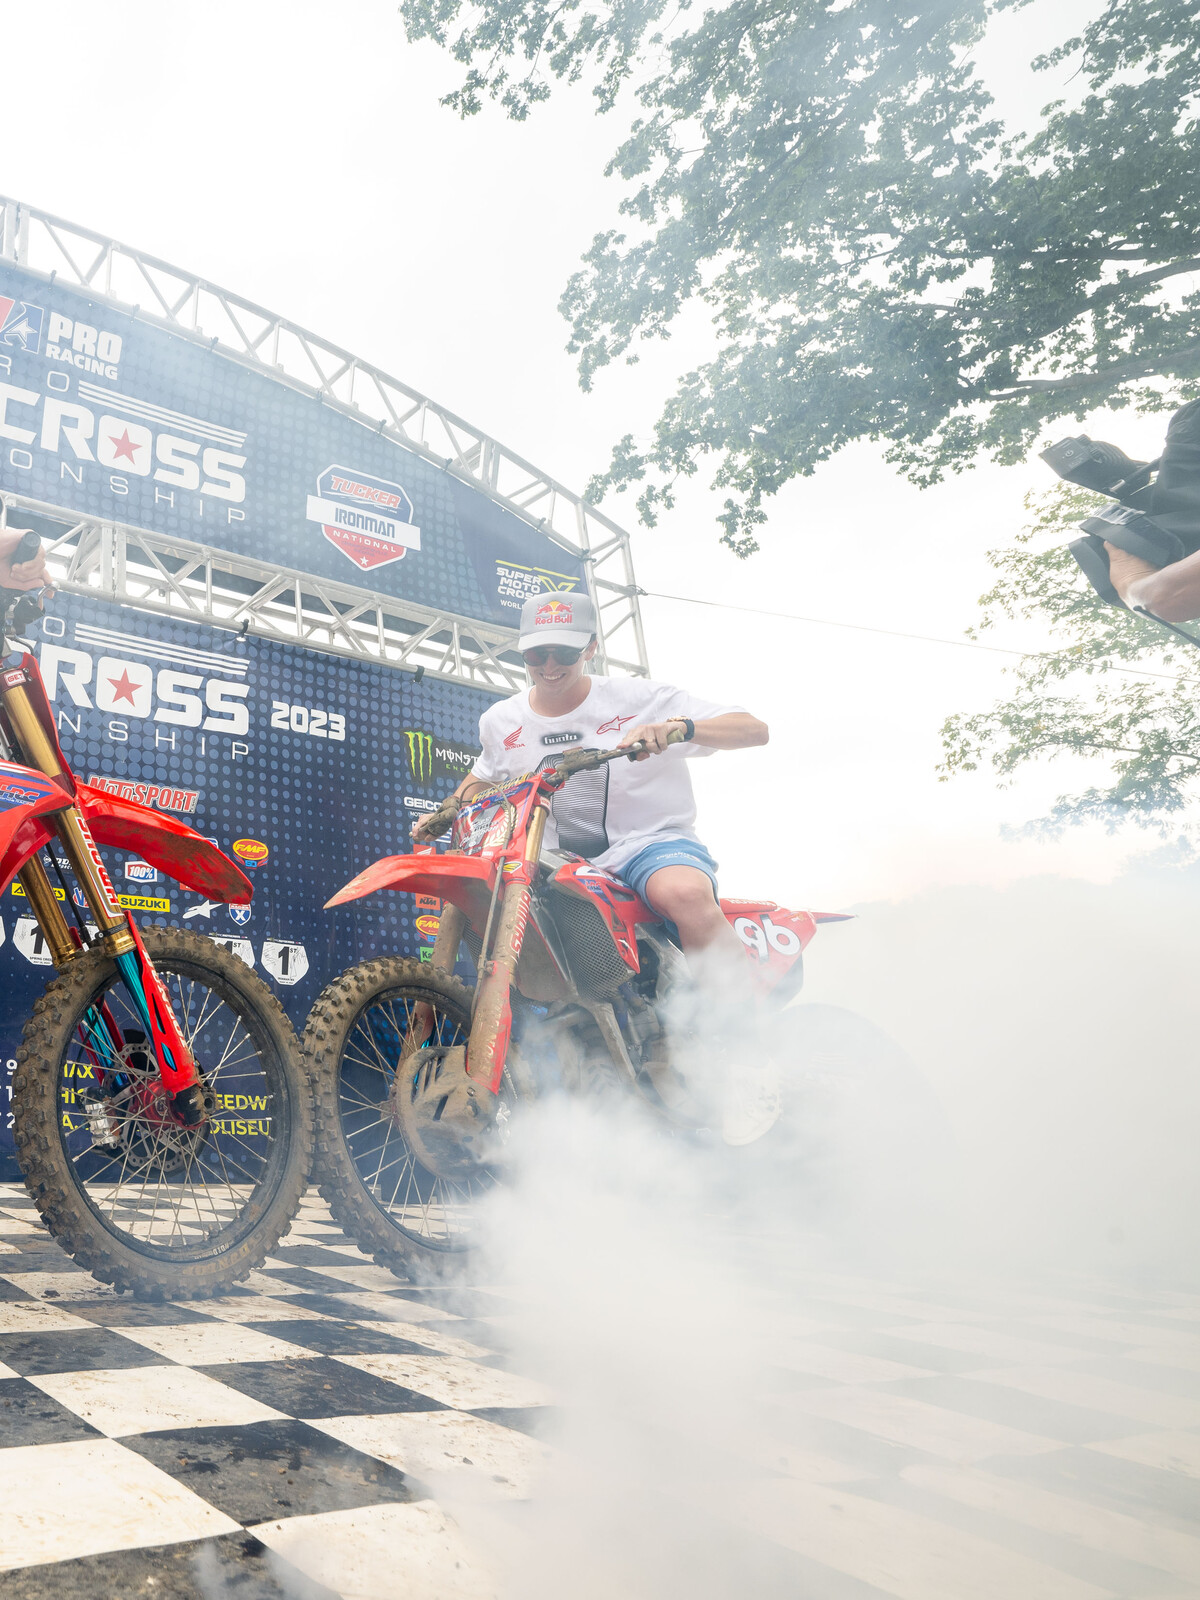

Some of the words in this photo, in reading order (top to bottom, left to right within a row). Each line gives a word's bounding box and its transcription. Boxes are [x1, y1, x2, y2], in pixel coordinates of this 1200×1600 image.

[47, 311, 123, 364] PRO
[45, 343, 118, 380] RACING
[330, 474, 401, 509] TUCKER
[335, 507, 396, 539] IRONMAN
[333, 530, 397, 553] NATIONAL
[496, 567, 542, 586] SUPER
[497, 586, 535, 600] CROS
[500, 576, 541, 594] MOTO
[500, 599, 524, 610] WORL
[535, 614, 553, 625] Red
[554, 614, 573, 624] Bull
[7, 672, 24, 684] GET
[270, 700, 346, 741] 2023
[505, 743, 526, 751] HONDA
[435, 748, 481, 766] MONST
[235, 844, 267, 853] FMF
[129, 865, 154, 879] 100%
[120, 897, 166, 909] SUZUKI
[420, 897, 437, 906] KTM
[235, 910, 246, 921] X
[734, 914, 801, 964] 96
